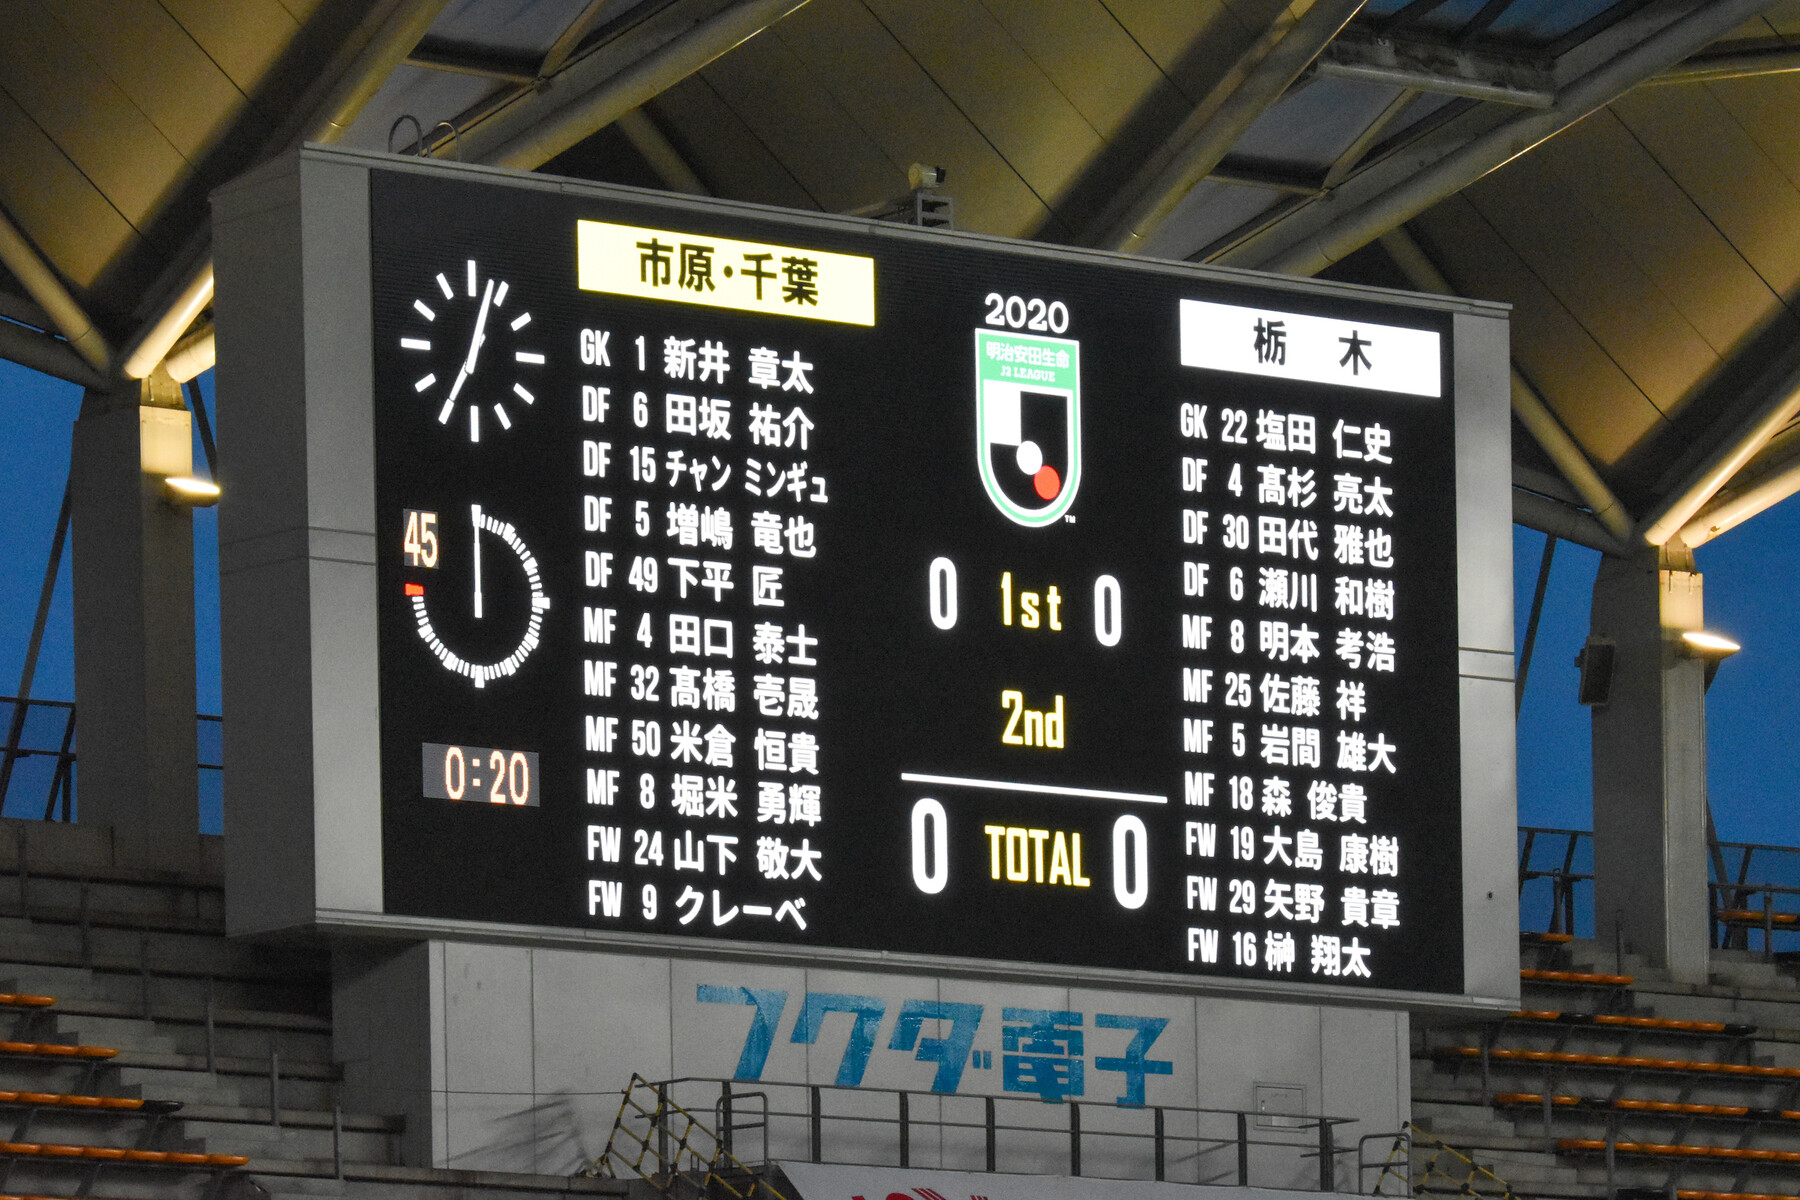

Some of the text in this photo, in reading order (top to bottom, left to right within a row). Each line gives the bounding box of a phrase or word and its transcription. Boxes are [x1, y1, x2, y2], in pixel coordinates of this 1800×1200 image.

[636, 237, 819, 307] 市原・千葉
[984, 292, 1069, 334] 2020
[580, 328, 815, 395] GK 1 新井 章太
[986, 341, 1069, 368] 明治安田生命
[1000, 365, 1055, 382] J2 LEAGUE
[582, 385, 815, 451] DF 6 田坂 祐介
[1180, 402, 1393, 465] GK 22 塩田 仁史
[583, 439, 612, 478] DF
[629, 445, 657, 483] 15
[1182, 456, 1208, 493] DF
[1227, 462, 1243, 498] 4
[1333, 472, 1394, 518] 亮太
[403, 511, 438, 568] 45
[583, 494, 817, 559] DF 5 増嶋 竜也
[1182, 508, 1395, 569] DF 30 田代 雅也
[584, 550, 786, 607] DF 49 下平 匠
[929, 556, 1122, 647] 0 1st 0
[1183, 561, 1210, 597] DF
[1229, 566, 1244, 602] 6
[1334, 575, 1395, 621] 和樹
[583, 606, 819, 666] MF 4 田口 泰士
[1182, 613, 1396, 673] MF 8 明本 考浩
[583, 659, 618, 698] MF
[630, 663, 660, 702] 32
[1182, 667, 1367, 722] MF 25 佐藤 祥
[585, 715, 820, 776] MF 50 米倉 恒貴
[1001, 689, 1065, 749] 2nd
[1183, 717, 1397, 774] MF 5 岩間 雄大
[444, 745, 530, 806] 0:20
[586, 768, 822, 827] MF 8 堀米 勇輝
[1184, 770, 1368, 825] MF 18 森 俊貴
[587, 824, 823, 882] FW 24 山下 敬大
[911, 797, 1149, 910] 0 TOTAL 0
[1185, 821, 1400, 878] FW 19 大島 康樹
[588, 879, 807, 931] FW 9 クレーベ
[1186, 875, 1401, 930] FW 29 矢野 貴章
[1187, 927, 1372, 979] FW 16 榊 翔太
[696, 983, 1174, 1109] フクダ電子
